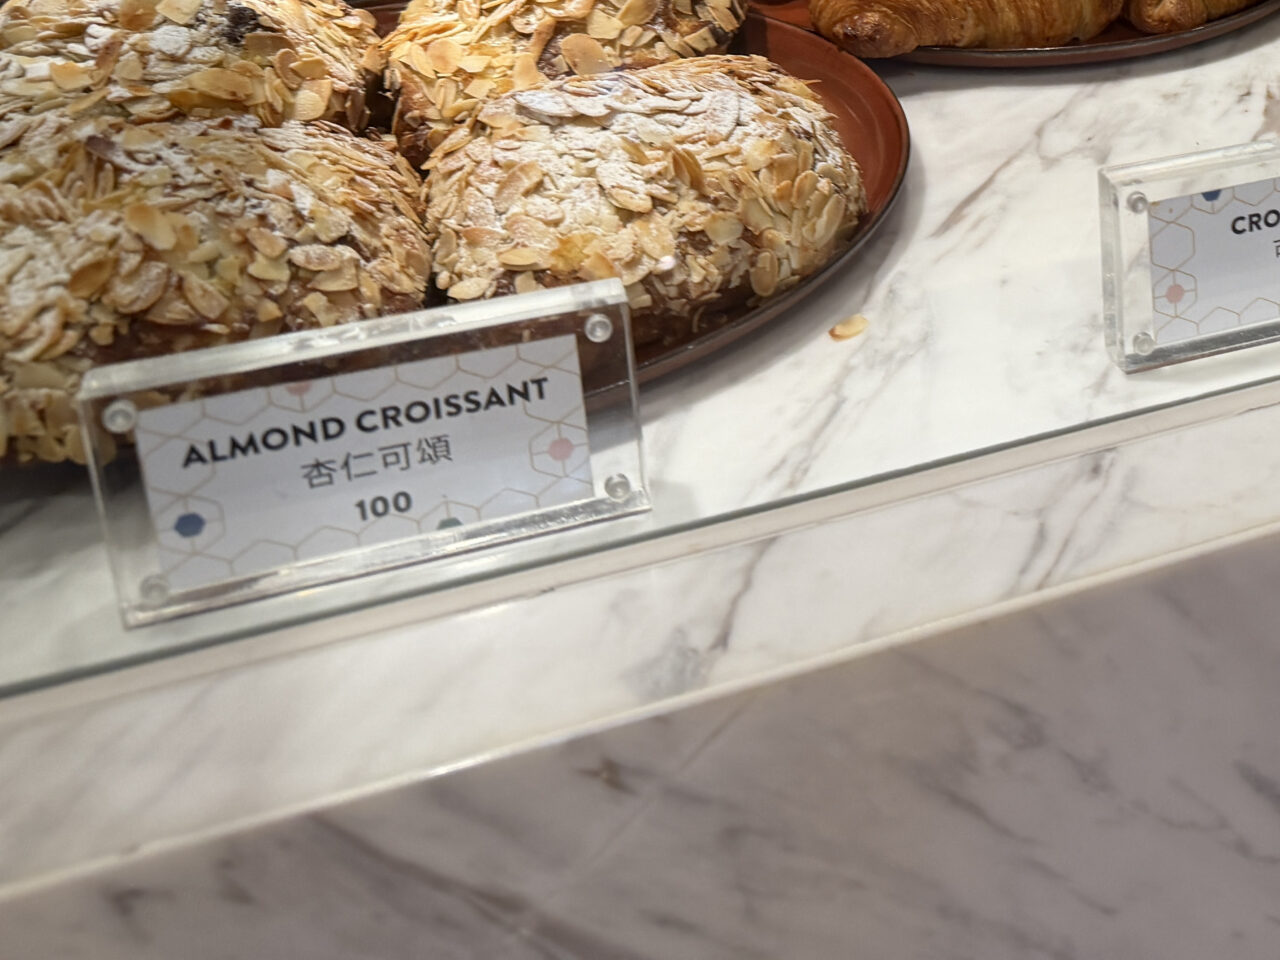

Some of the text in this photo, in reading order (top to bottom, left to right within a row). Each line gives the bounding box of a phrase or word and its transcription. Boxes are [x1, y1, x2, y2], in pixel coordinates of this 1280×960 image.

[182, 377, 549, 468] ALMOND CROISSANT
[303, 435, 453, 490] 杏仁可頌
[357, 492, 412, 520] 100
